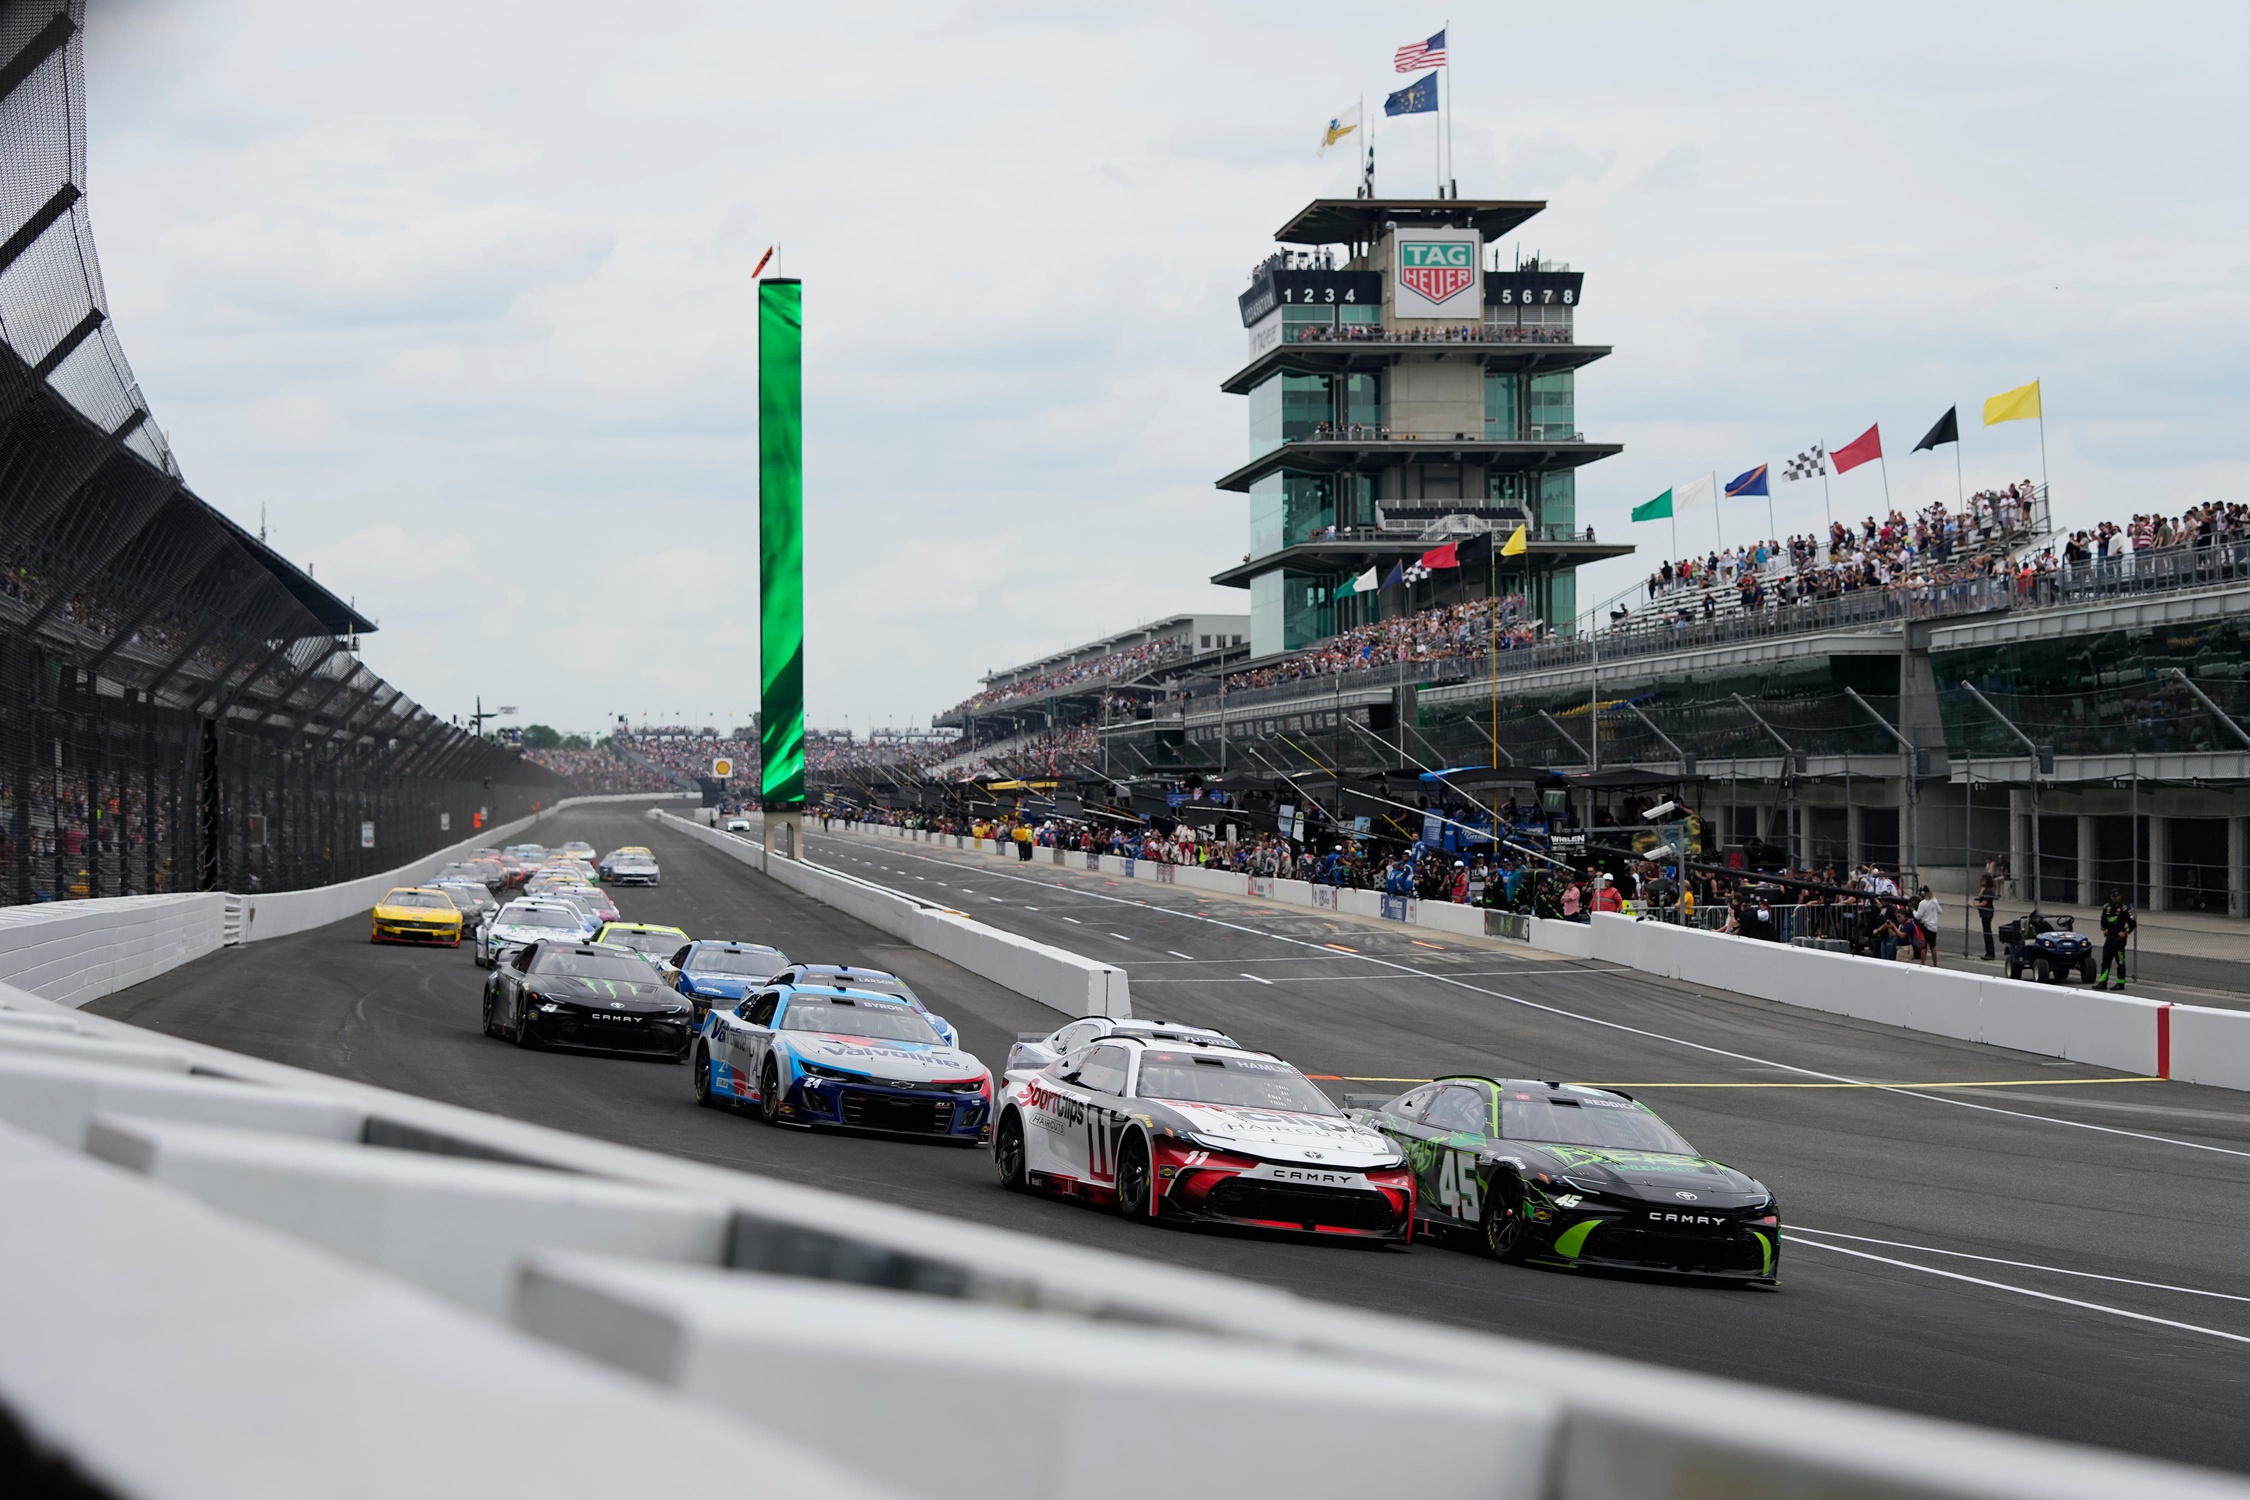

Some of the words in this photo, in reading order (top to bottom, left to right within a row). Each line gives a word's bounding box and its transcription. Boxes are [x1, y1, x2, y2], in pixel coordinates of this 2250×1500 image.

[1406, 246, 1466, 266] TAG
[1404, 268, 1469, 299] HEUER
[1284, 288, 1292, 302] 1
[1304, 288, 1314, 302] 2
[1325, 288, 1335, 303] 3
[1345, 288, 1356, 303] 4
[1502, 289, 1512, 304] 5
[1522, 289, 1532, 304] 6
[1543, 289, 1553, 304] 7
[1563, 289, 1574, 304] 8
[858, 977, 894, 985] LARSON
[863, 1001, 904, 1012] BYRON
[592, 1013, 643, 1023] CAMRY
[822, 1045, 960, 1068] Valvoline
[1236, 1060, 1293, 1074] HAMLIN
[803, 1077, 823, 1089] 24
[1583, 1098, 1639, 1111] REDDICK
[1032, 1114, 1066, 1134] HAIRCUTS
[1088, 1106, 1114, 1176] 11
[1184, 1151, 1210, 1166] 11
[1273, 1169, 1353, 1184] CAMRY
[1439, 1149, 1481, 1223] 45
[1554, 1193, 1583, 1208] 45
[1649, 1212, 1727, 1226] CAMRY
